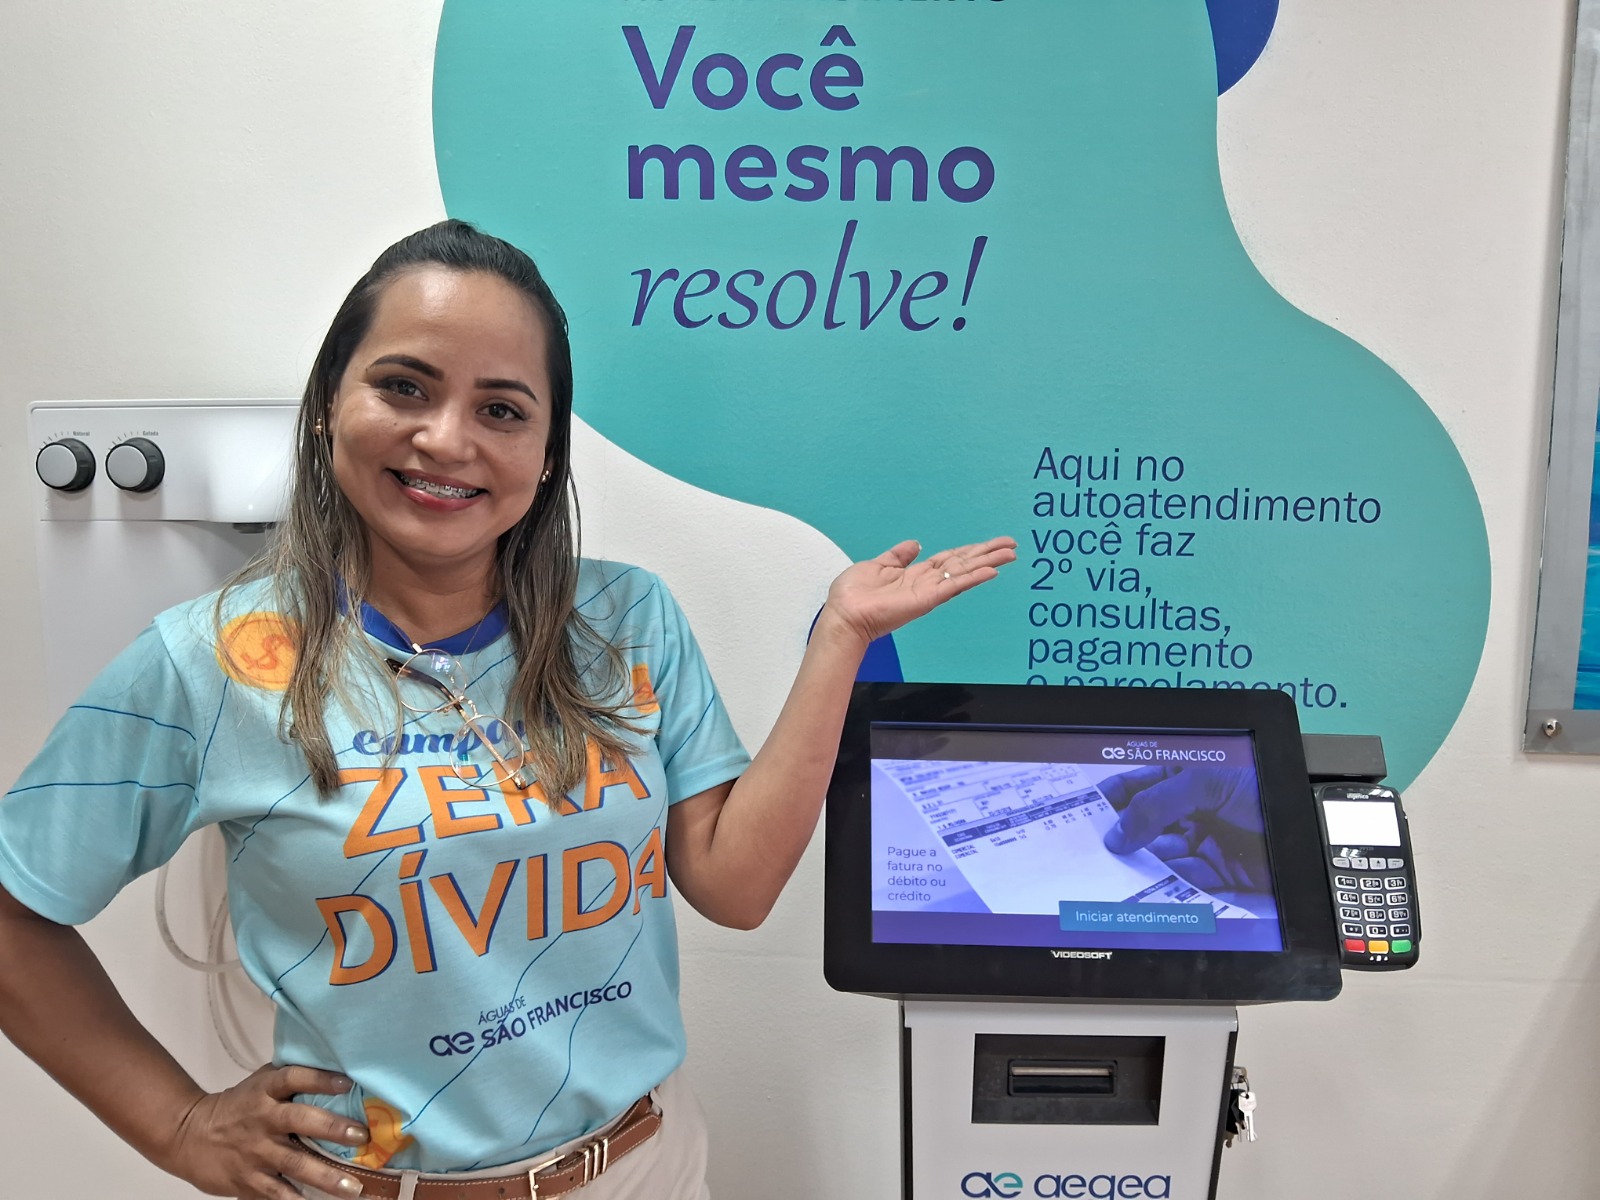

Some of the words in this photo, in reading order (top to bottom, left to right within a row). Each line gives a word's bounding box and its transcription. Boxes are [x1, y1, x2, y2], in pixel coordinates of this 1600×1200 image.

[621, 25, 864, 110] Você
[628, 144, 995, 203] mesmo
[630, 219, 988, 331] resolve!
[1033, 447, 1120, 487] Aqui
[1136, 454, 1185, 482] no
[1032, 487, 1382, 523] autoatendimento
[1031, 521, 1122, 555] você
[1136, 523, 1196, 557] faz
[1030, 558, 1073, 591] 2º
[1086, 560, 1152, 598] via,
[1029, 598, 1231, 637] consultas,
[1028, 638, 1253, 672] pagamento
[1127, 748, 1152, 760] SÃO
[1156, 750, 1226, 762] FRANCISCO
[338, 736, 651, 859] ZERA
[887, 846, 926, 858] Pague
[930, 849, 937, 857] a
[887, 861, 923, 871] fatura
[927, 864, 943, 872] no
[887, 876, 927, 886] débito
[930, 879, 946, 887] ou
[887, 891, 931, 901] crédito
[315, 826, 666, 985] DÍVIDA
[1075, 910, 1113, 923] Iniciar
[1116, 911, 1199, 924] atendimento
[1050, 950, 1113, 960] VIDEOSOFT
[478, 1001, 515, 1026] ÁGUAS
[515, 995, 526, 1010] DE
[481, 1017, 526, 1049] SÃO
[527, 981, 632, 1030] FRANCISCO
